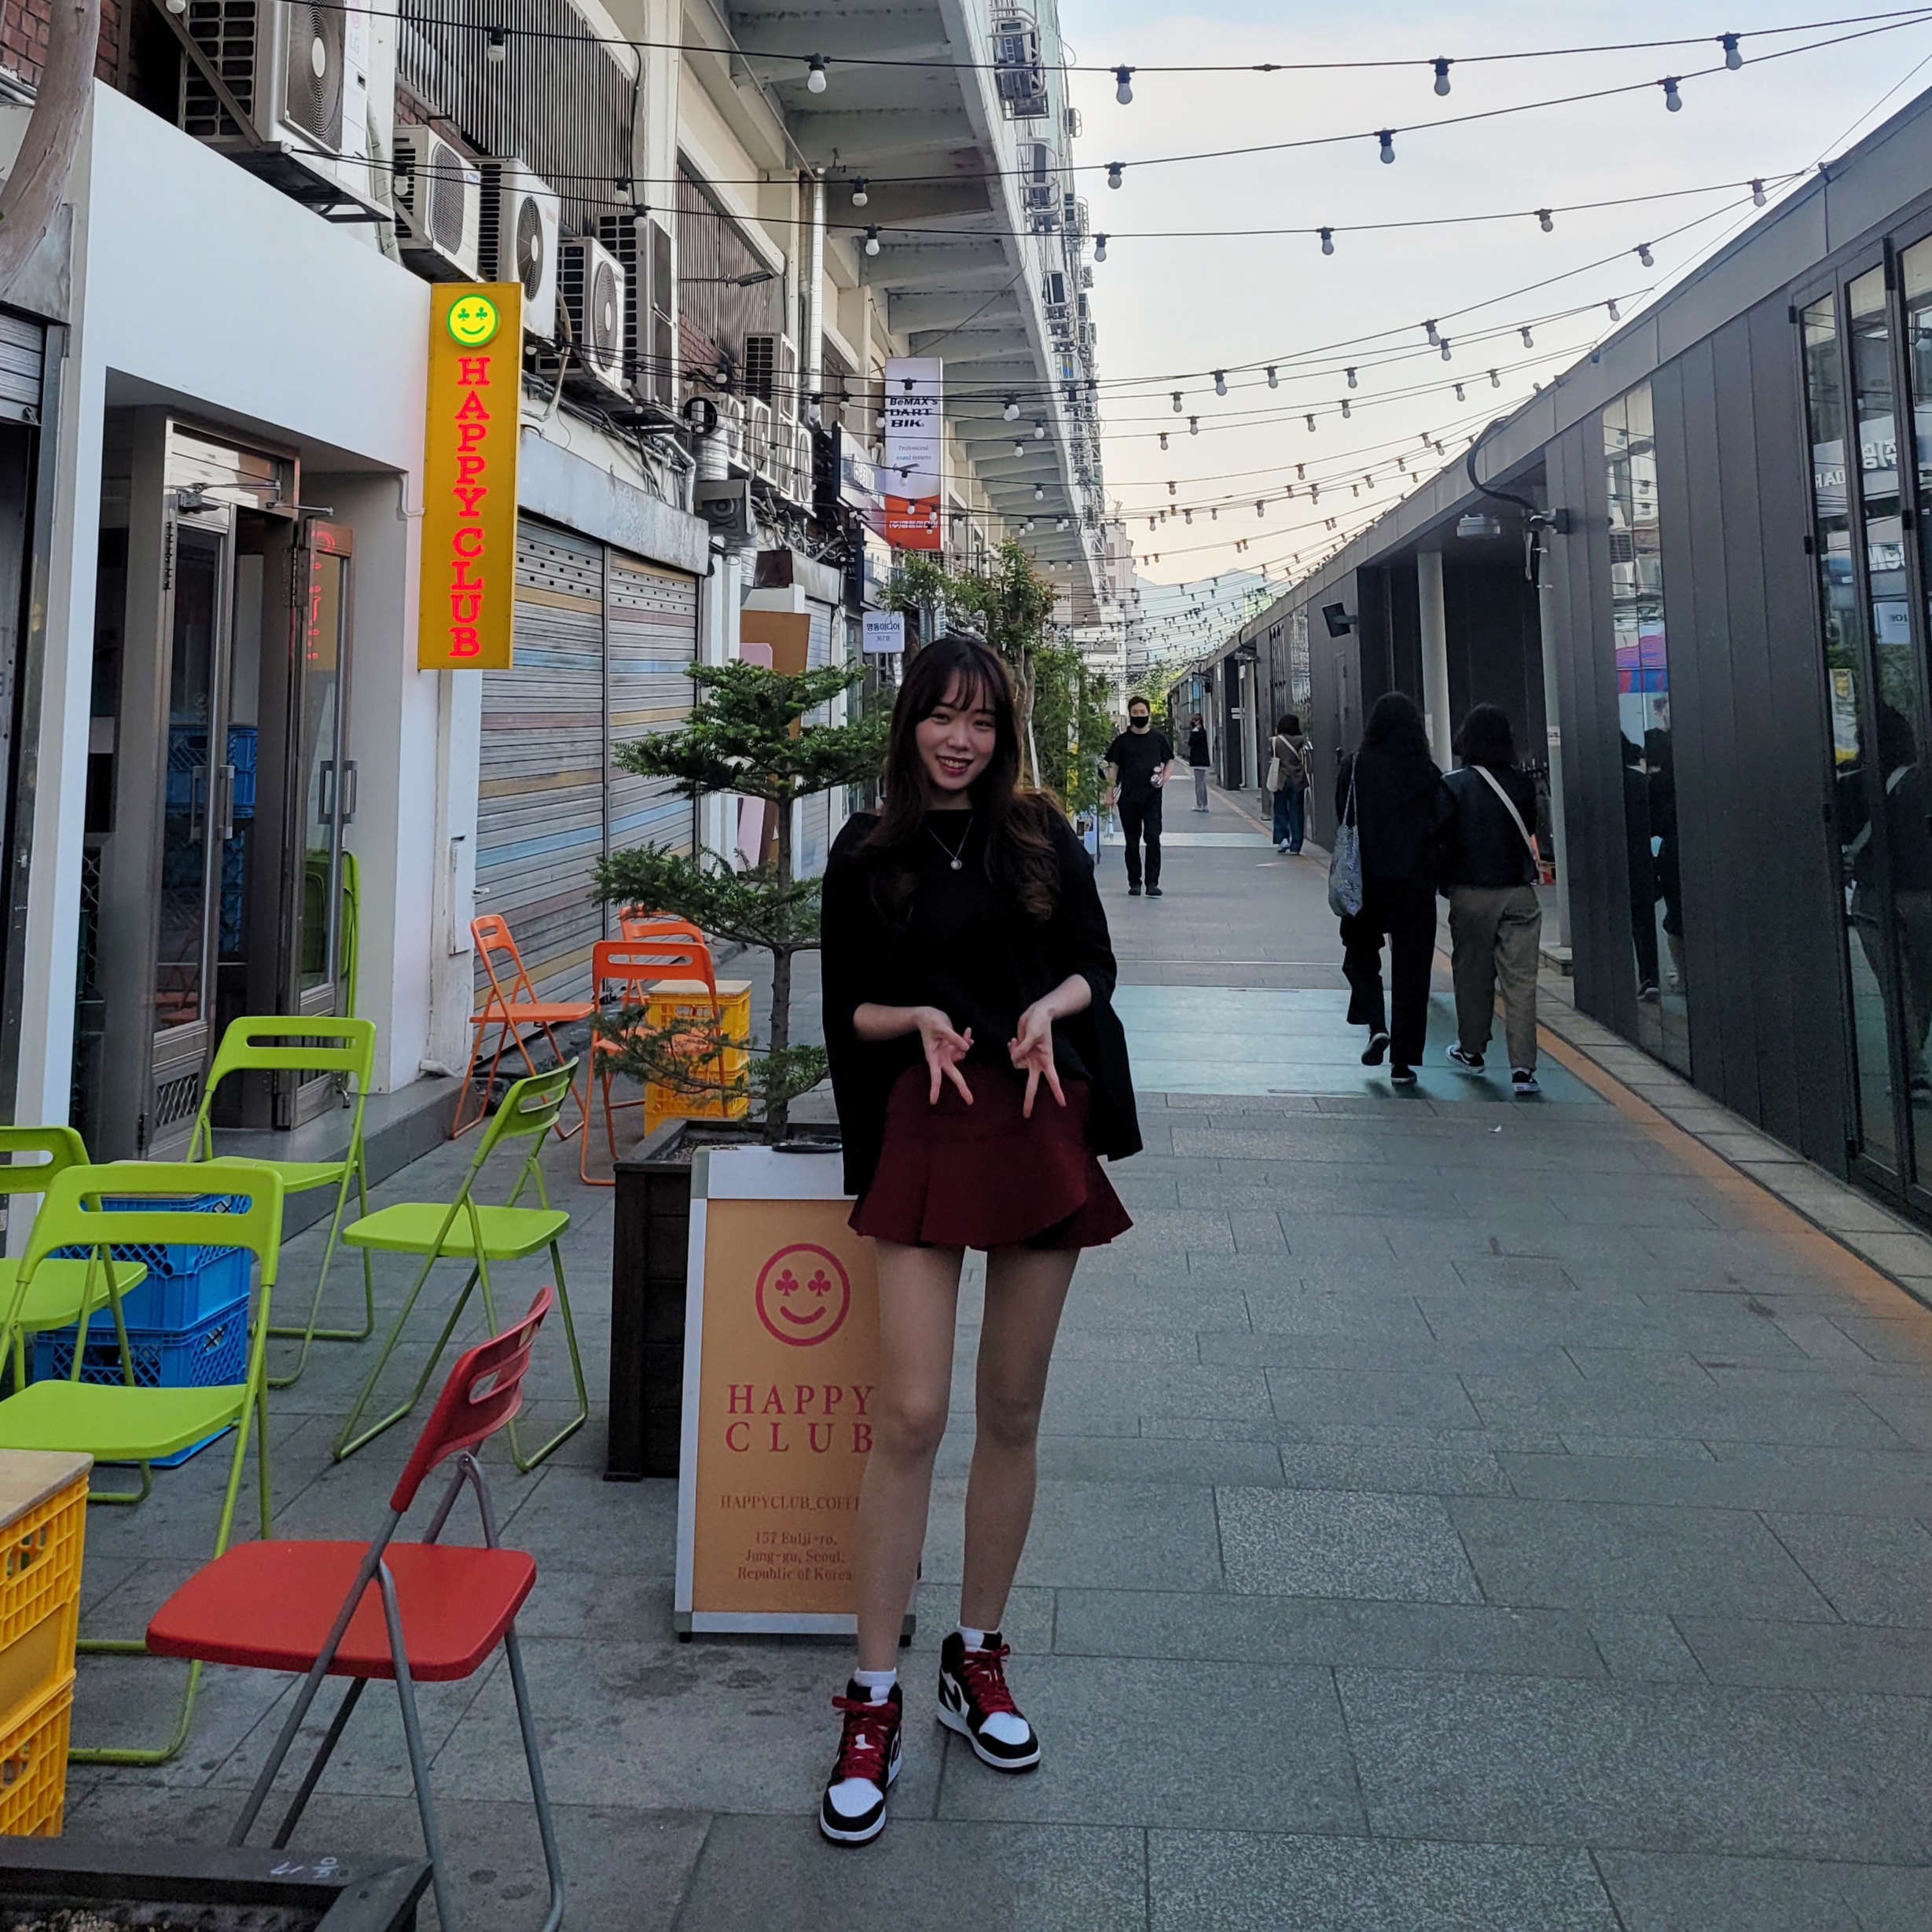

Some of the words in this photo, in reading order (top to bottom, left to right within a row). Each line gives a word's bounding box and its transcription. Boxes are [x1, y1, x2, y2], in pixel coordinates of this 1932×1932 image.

[349, 32, 359, 54] LG
[890, 397, 938, 406] BeMAXs
[890, 408, 933, 417] DART
[454, 357, 490, 517] HAPPY
[449, 527, 483, 657] CLUB
[866, 623, 900, 631] 명동미디어
[727, 1384, 874, 1415] HAPPY
[725, 1421, 872, 1453] CLUB
[737, 1567, 793, 1580] Republic
[798, 1567, 810, 1580] of
[814, 1567, 853, 1581] Korea
